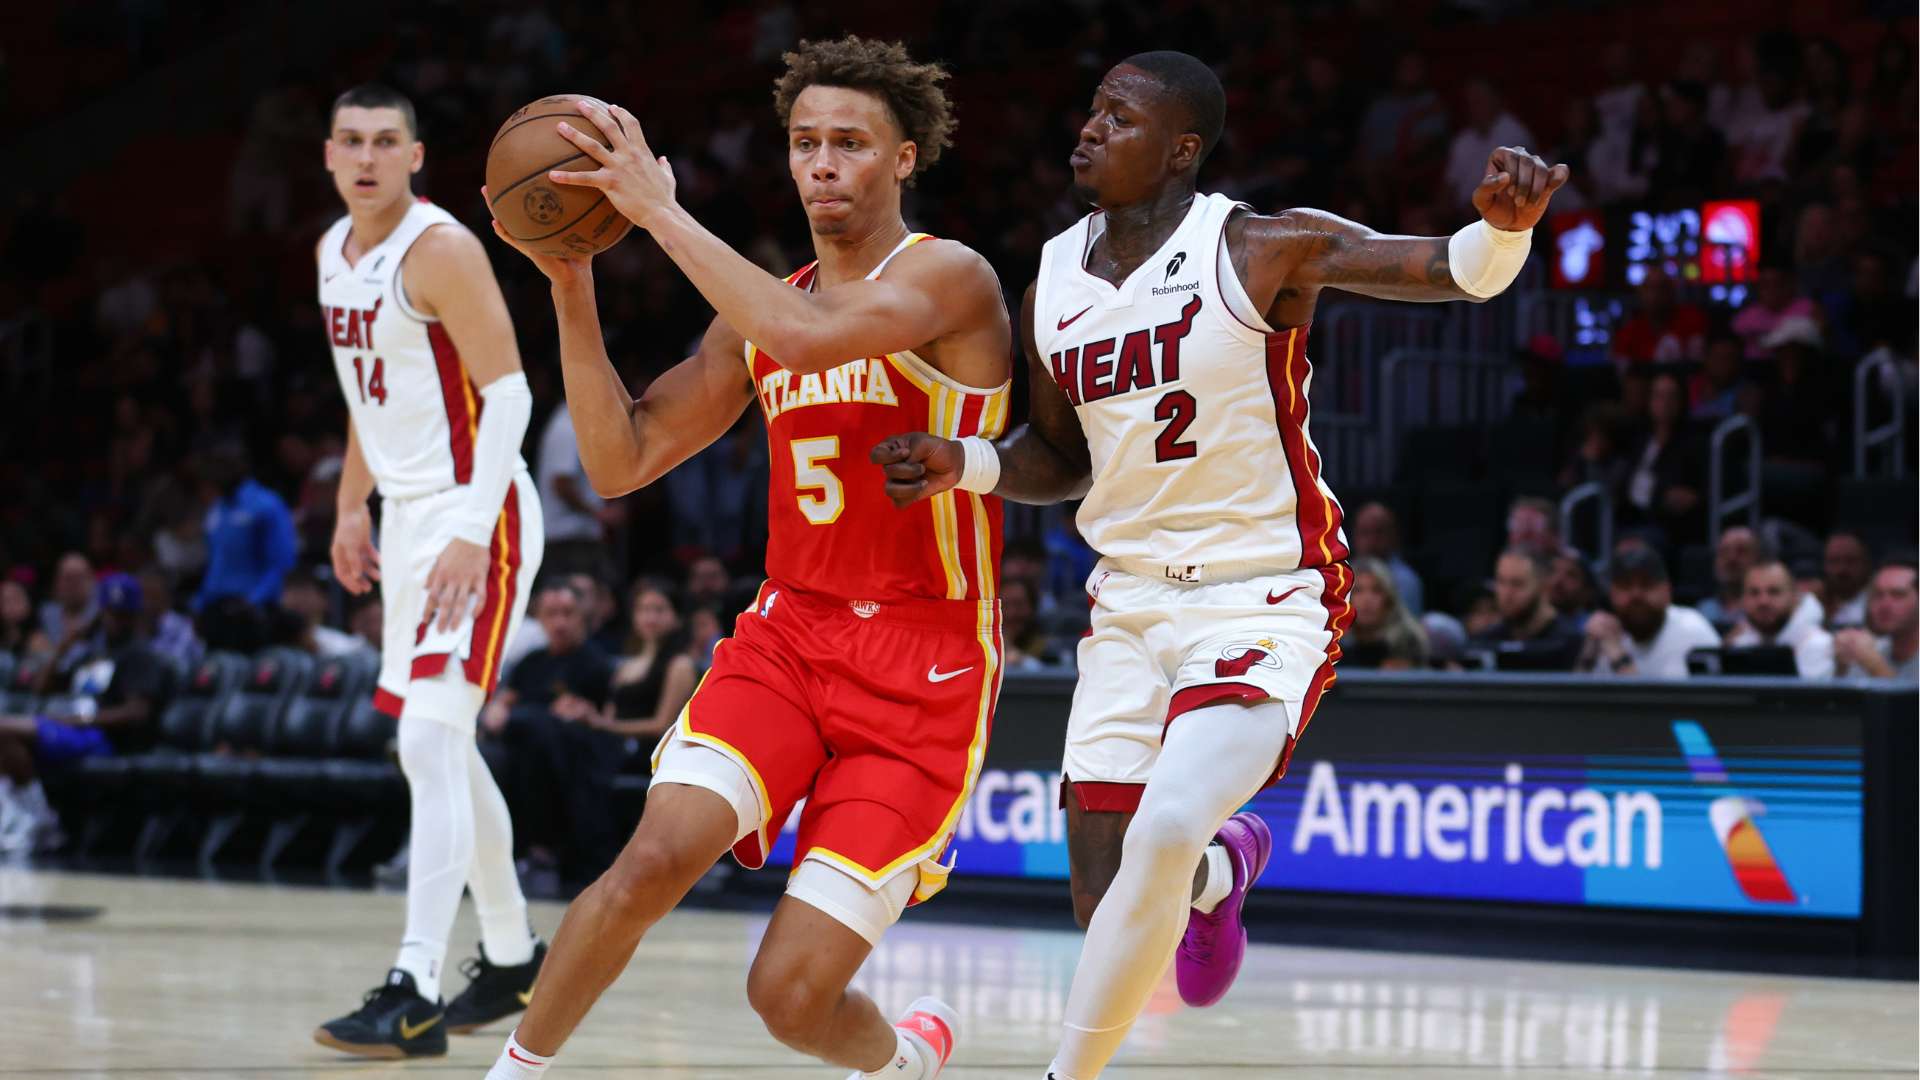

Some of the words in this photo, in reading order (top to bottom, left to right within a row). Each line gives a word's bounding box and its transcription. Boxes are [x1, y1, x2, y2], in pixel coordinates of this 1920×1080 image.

[1152, 281, 1199, 296] Robinhood
[353, 357, 388, 406] 14
[1050, 294, 1202, 407] HEAT
[1154, 389, 1197, 463] 2
[790, 435, 845, 525] 5
[1292, 761, 1663, 870] American
